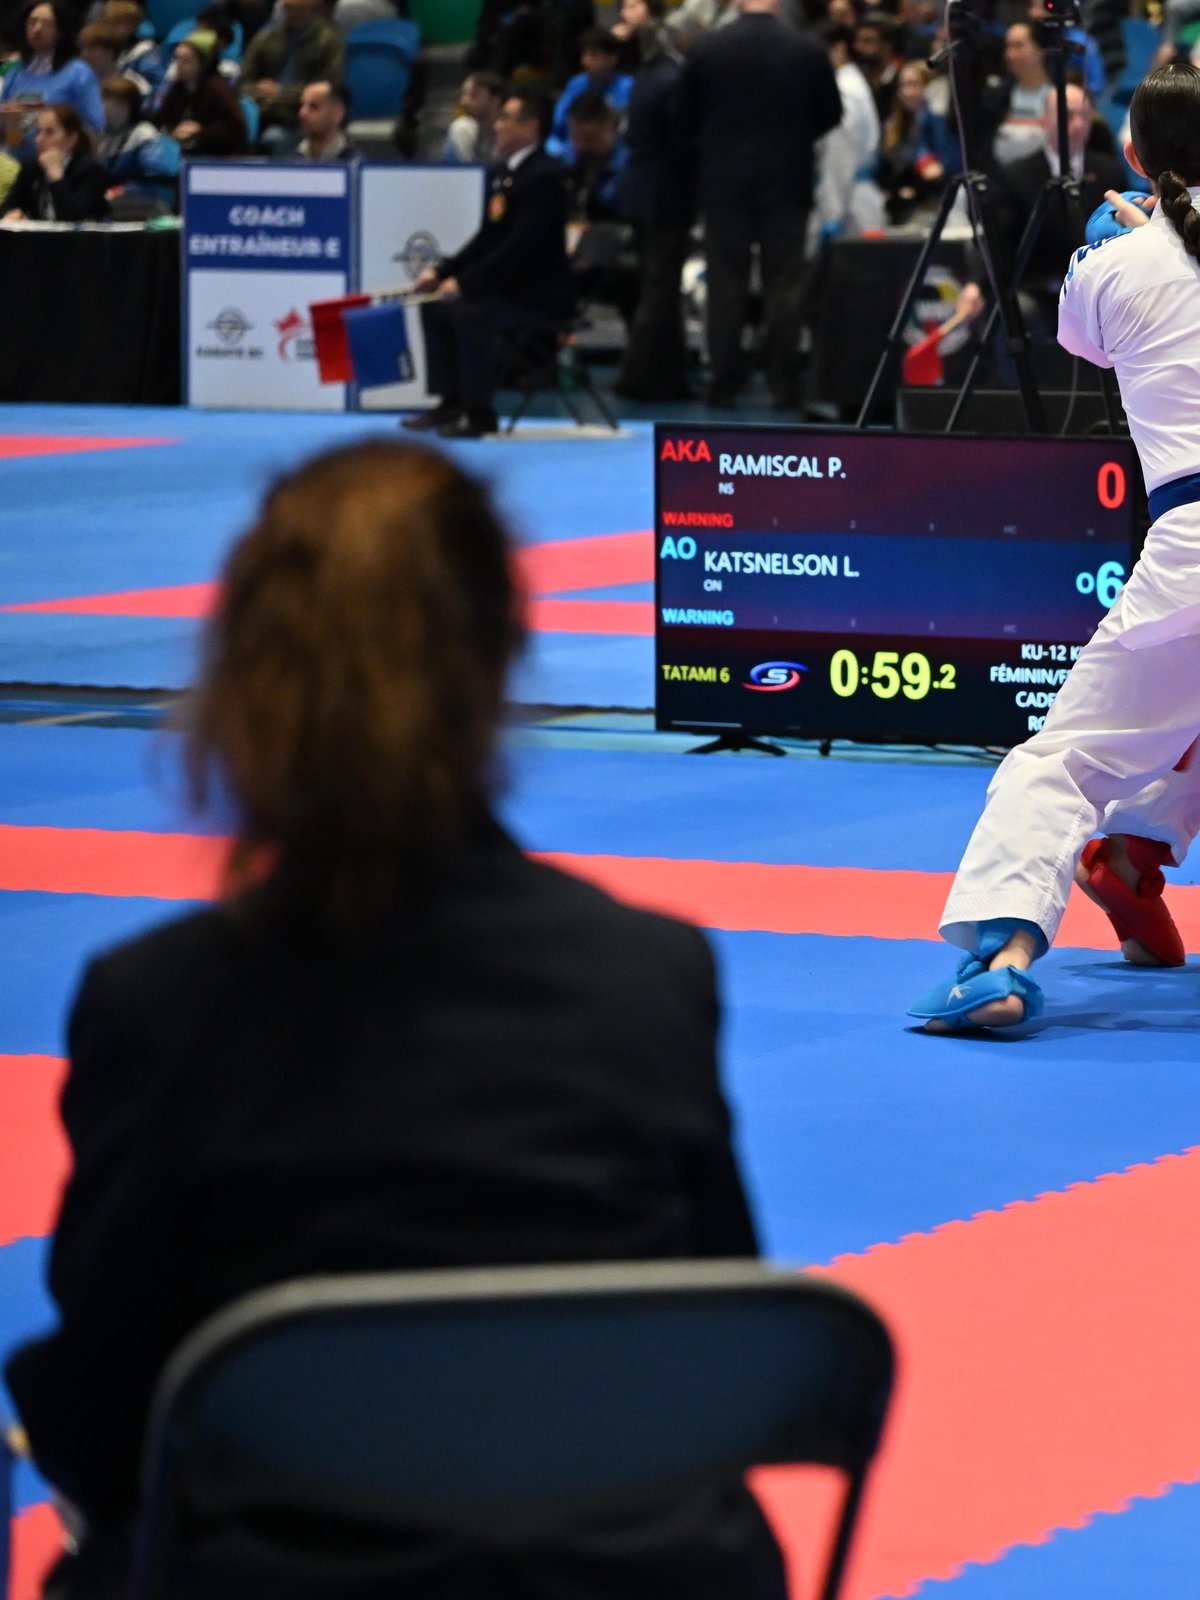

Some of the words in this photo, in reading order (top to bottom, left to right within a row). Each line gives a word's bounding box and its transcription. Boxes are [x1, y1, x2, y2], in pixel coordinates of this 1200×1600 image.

[228, 205, 305, 227] COACH
[660, 439, 712, 463] AKA
[718, 453, 824, 478] RAMISCAL
[827, 456, 847, 479] P.
[718, 481, 735, 495] NS
[1096, 461, 1126, 509] 0
[662, 511, 734, 528] WARNING
[660, 536, 697, 560] AO
[704, 551, 838, 577] KATSNELSON
[843, 555, 860, 578] L.
[703, 578, 723, 592] ON
[662, 608, 734, 626] WARNING
[1021, 643, 1067, 661] KU-12
[662, 664, 717, 682] TATAMI
[719, 667, 730, 683] 6
[1015, 691, 1058, 708] CADE
